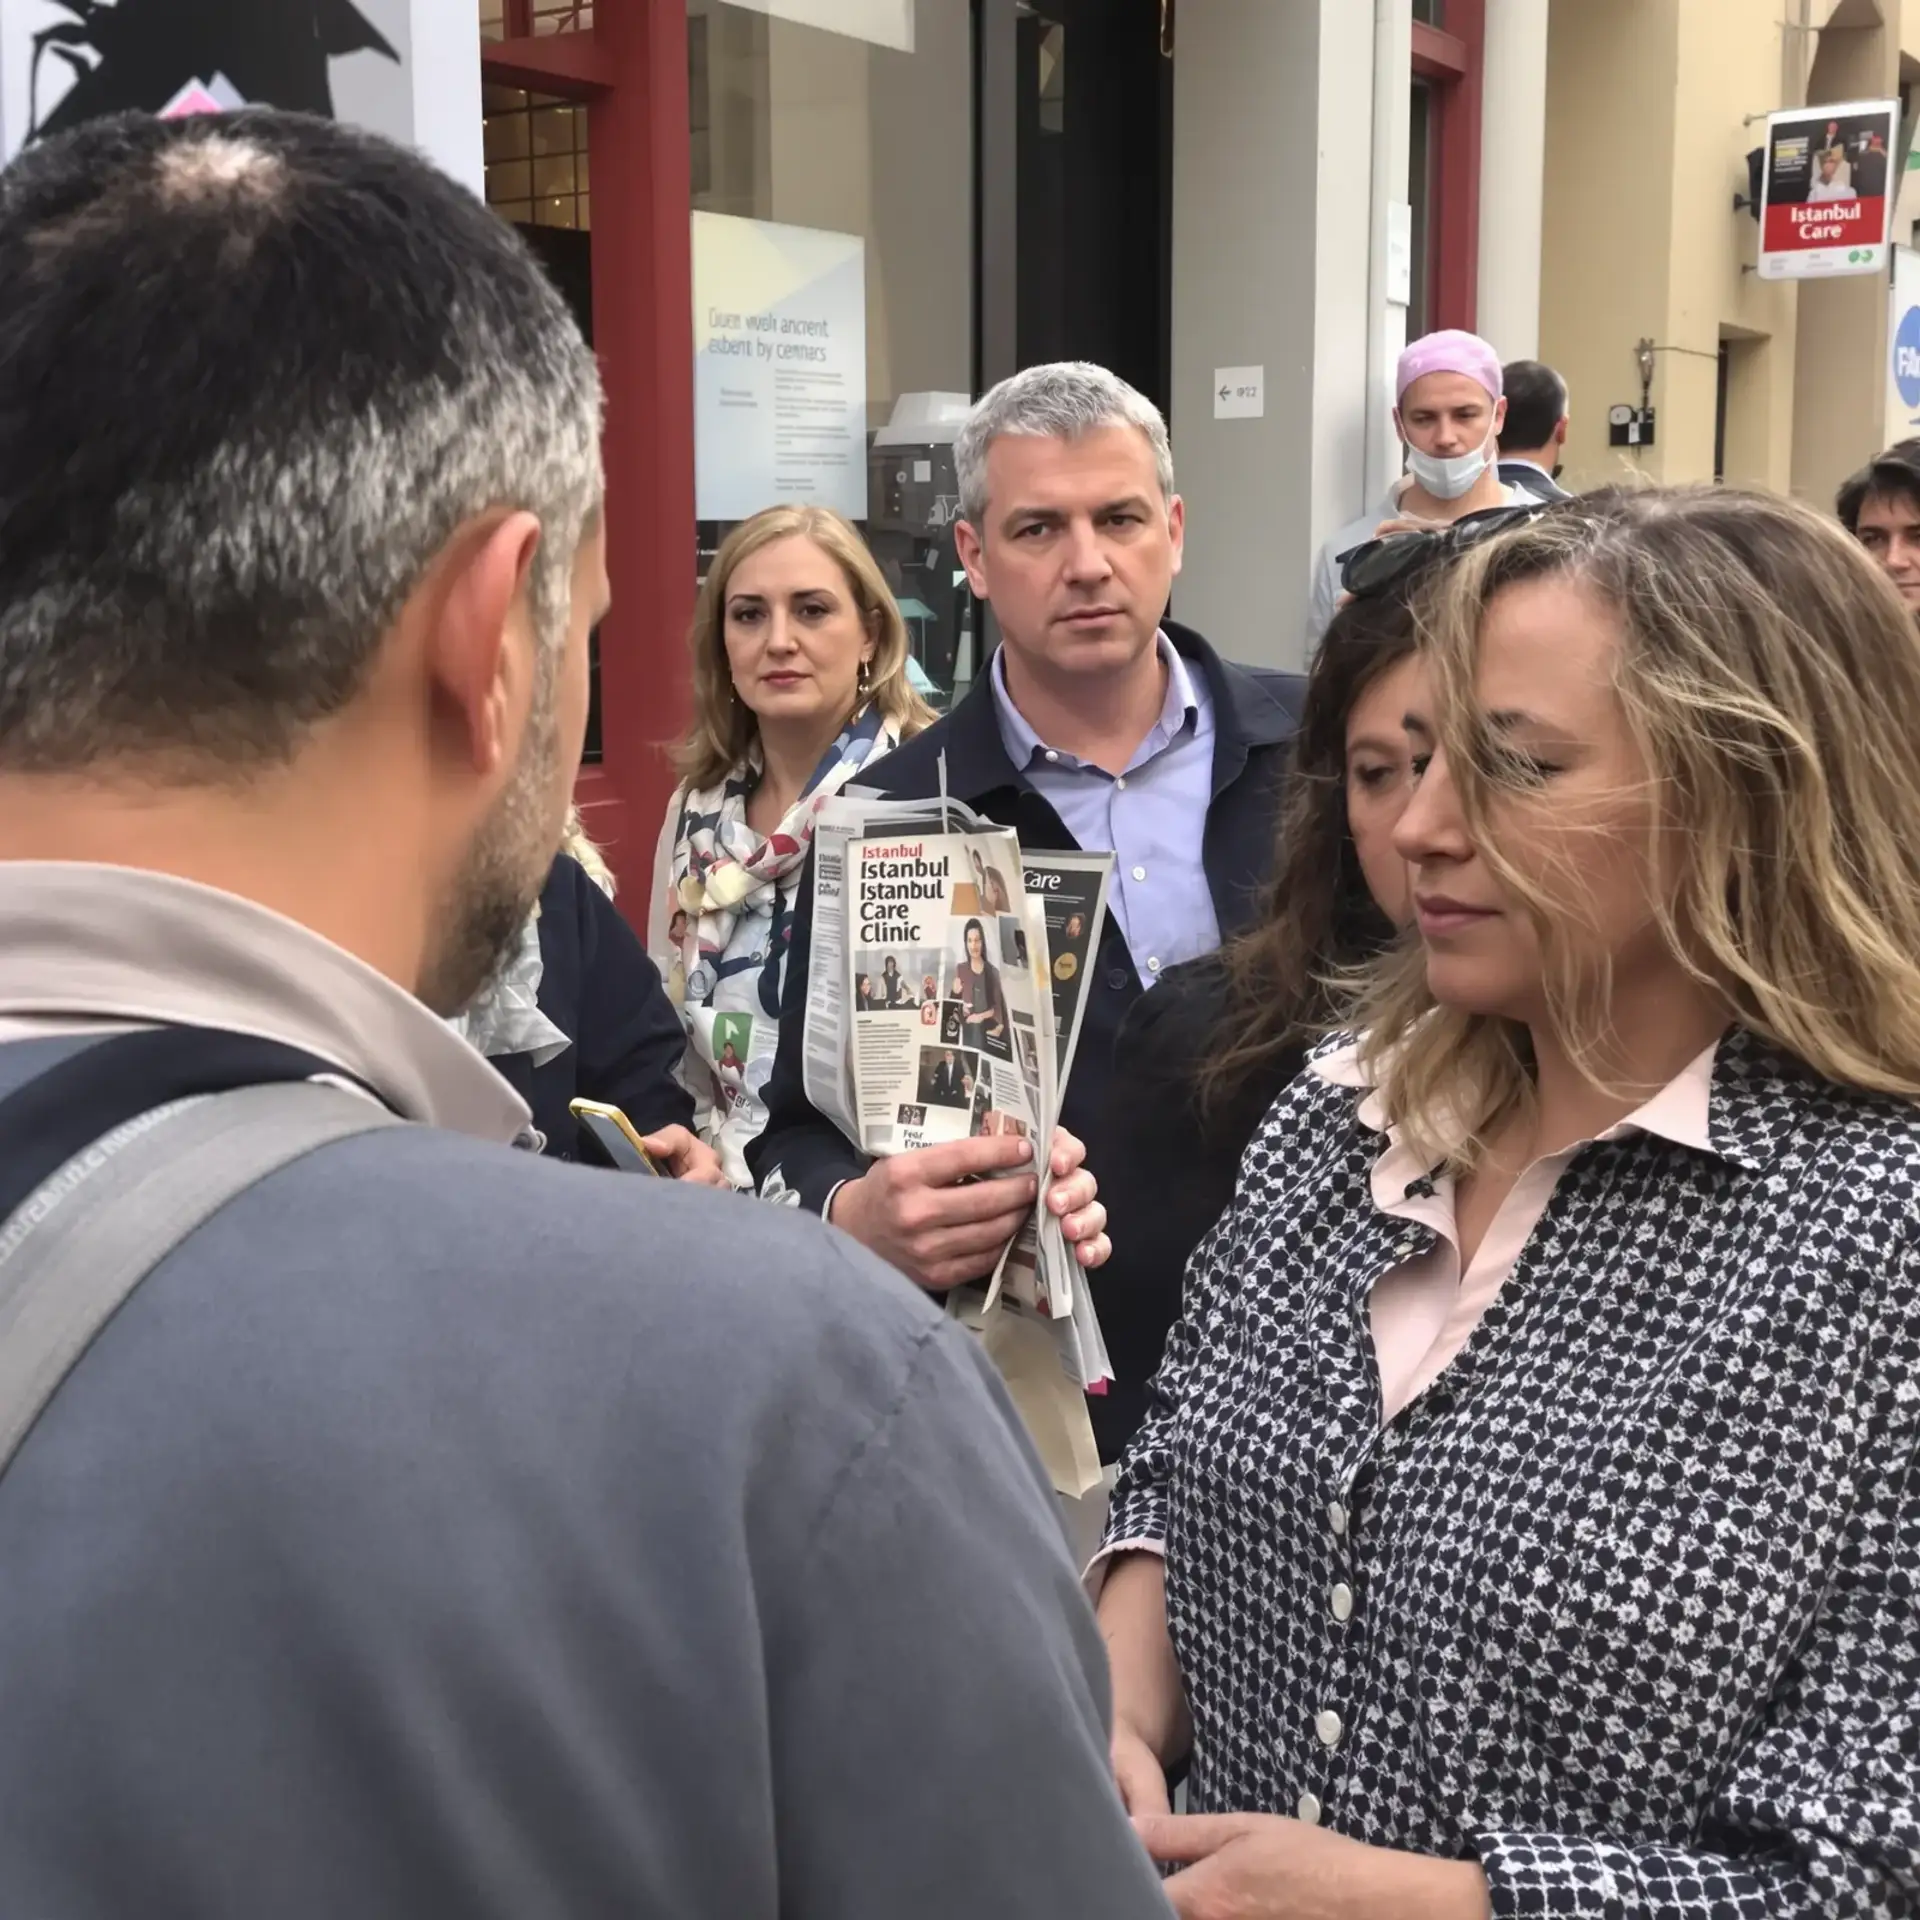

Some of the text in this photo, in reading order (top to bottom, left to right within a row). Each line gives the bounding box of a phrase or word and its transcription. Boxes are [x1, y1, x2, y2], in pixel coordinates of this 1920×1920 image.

[1791, 203, 1861, 223] Istanbul
[1799, 223, 1843, 240] Care
[757, 337, 774, 362] by
[863, 843, 922, 859] Istanbul
[861, 856, 949, 879] Istanbul
[860, 879, 945, 900] Istanbul
[1023, 870, 1061, 890] Care
[860, 902, 909, 921] Care
[860, 921, 921, 943] Clinic
